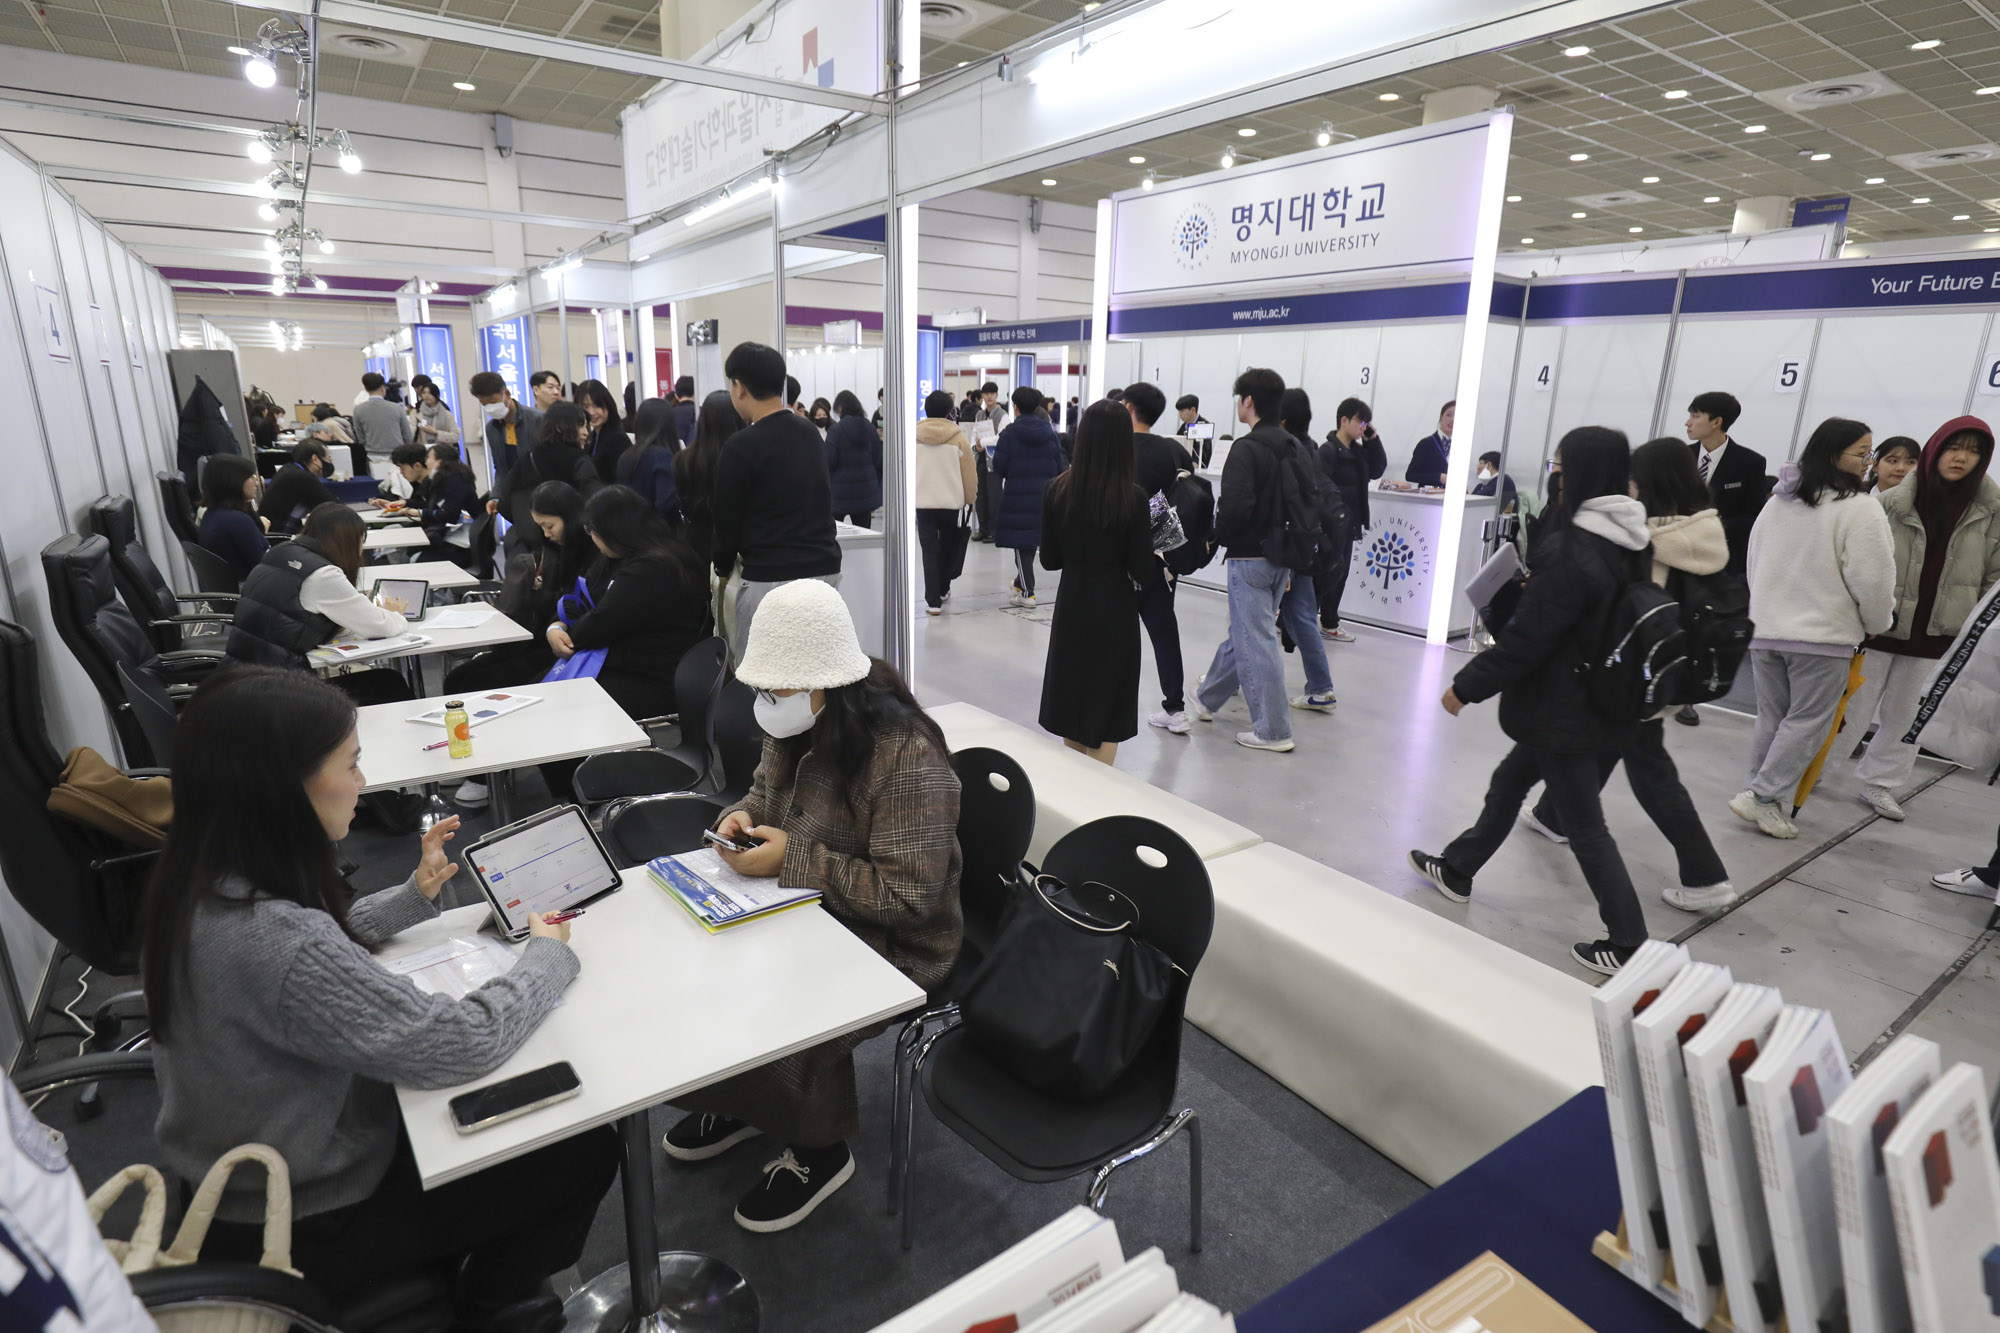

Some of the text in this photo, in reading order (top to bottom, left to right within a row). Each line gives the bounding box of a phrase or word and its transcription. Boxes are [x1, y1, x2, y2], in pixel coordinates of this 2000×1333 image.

[1231, 182, 1385, 242] 명지대학교
[1230, 244, 1289, 264] MYONGJI
[1294, 232, 1380, 256] UNIVERSITY
[1871, 277, 1913, 294] Your
[1918, 274, 1984, 292] Future
[1232, 305, 1290, 321] www.mju.ac.kr
[1155, 367, 1160, 381] 1
[1360, 366, 1370, 385] 3
[1537, 365, 1550, 385] 4
[1780, 362, 1799, 387] 5
[1988, 360, 2000, 388] 6
[1389, 517, 1430, 575] UNIVERSITY
[1918, 638, 1978, 721] UNDER ARMOUR
